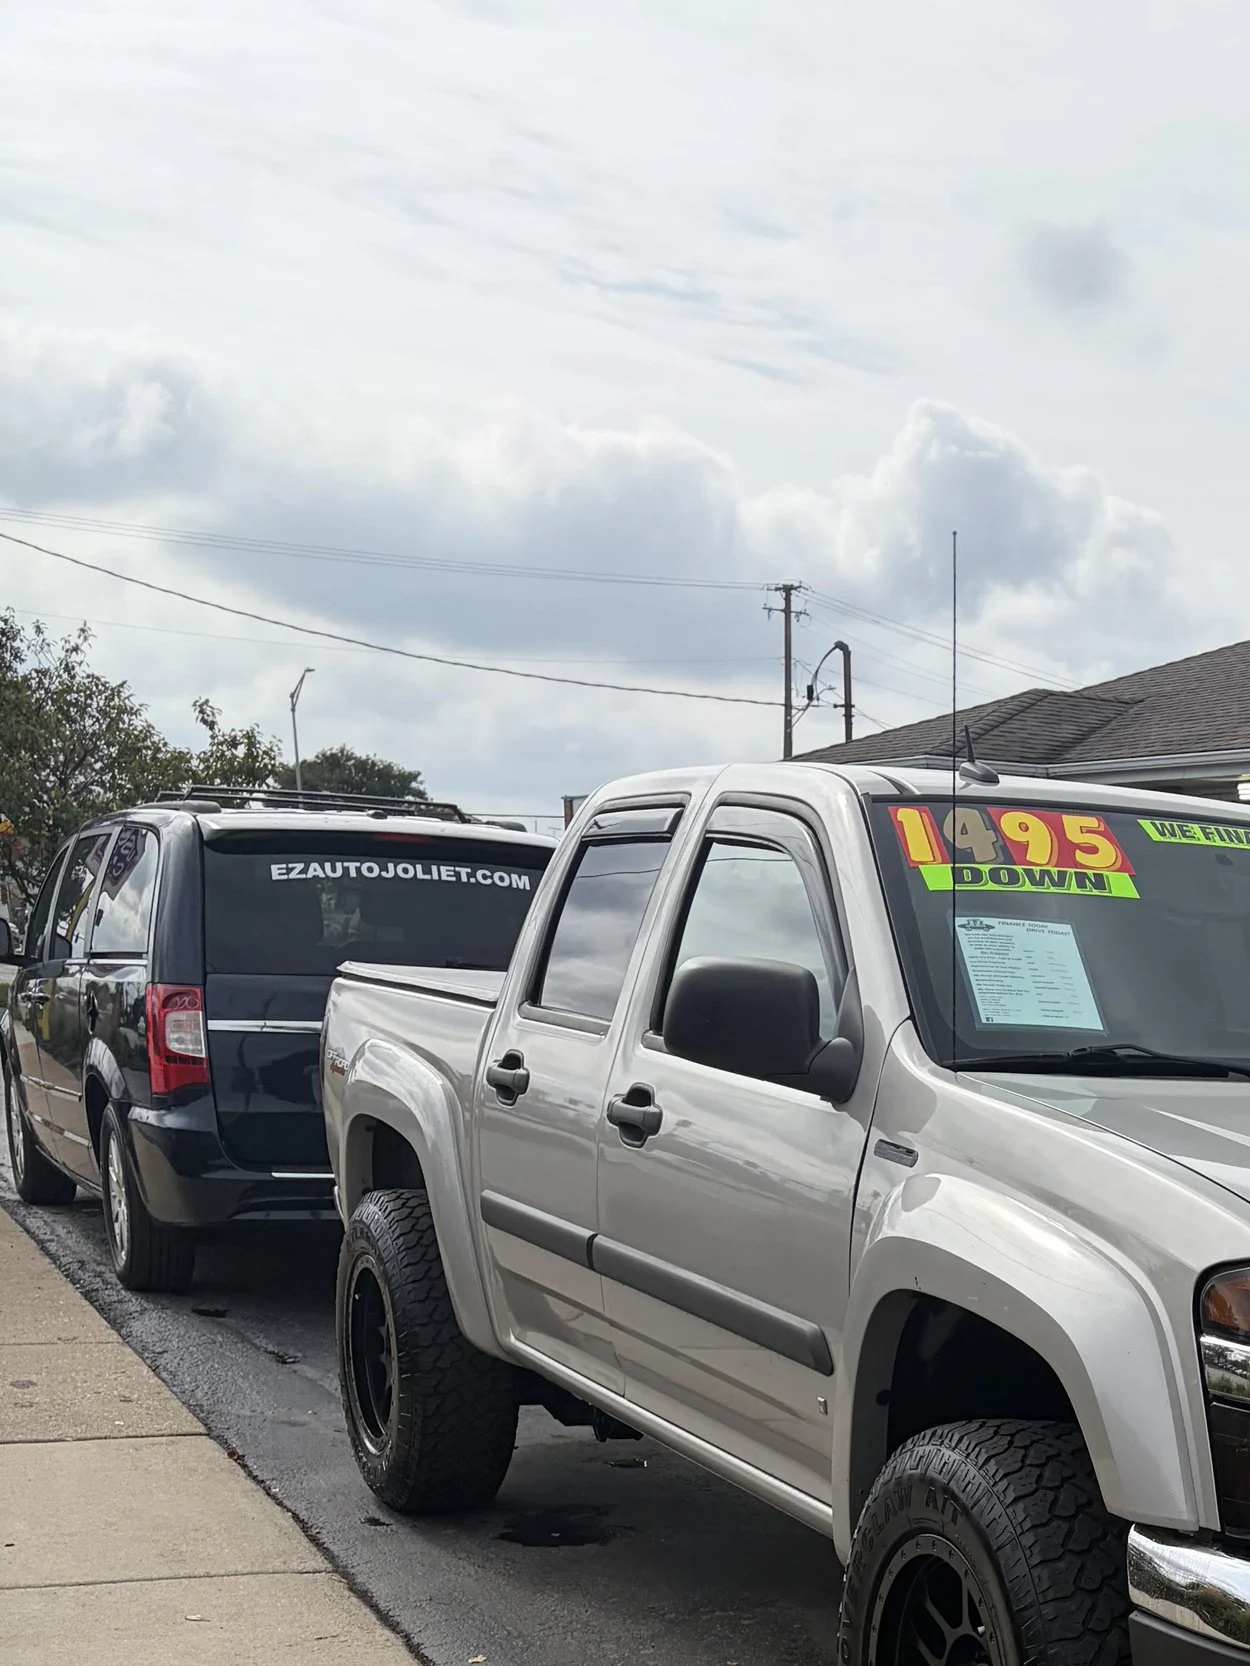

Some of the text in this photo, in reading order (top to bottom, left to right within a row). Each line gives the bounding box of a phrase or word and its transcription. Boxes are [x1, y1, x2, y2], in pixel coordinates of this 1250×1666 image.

[896, 807, 1122, 871] 1495
[1150, 821, 1199, 841] WE
[270, 861, 531, 891] EZAUTOJOLIET.COM
[951, 866, 1113, 894] DOWN
